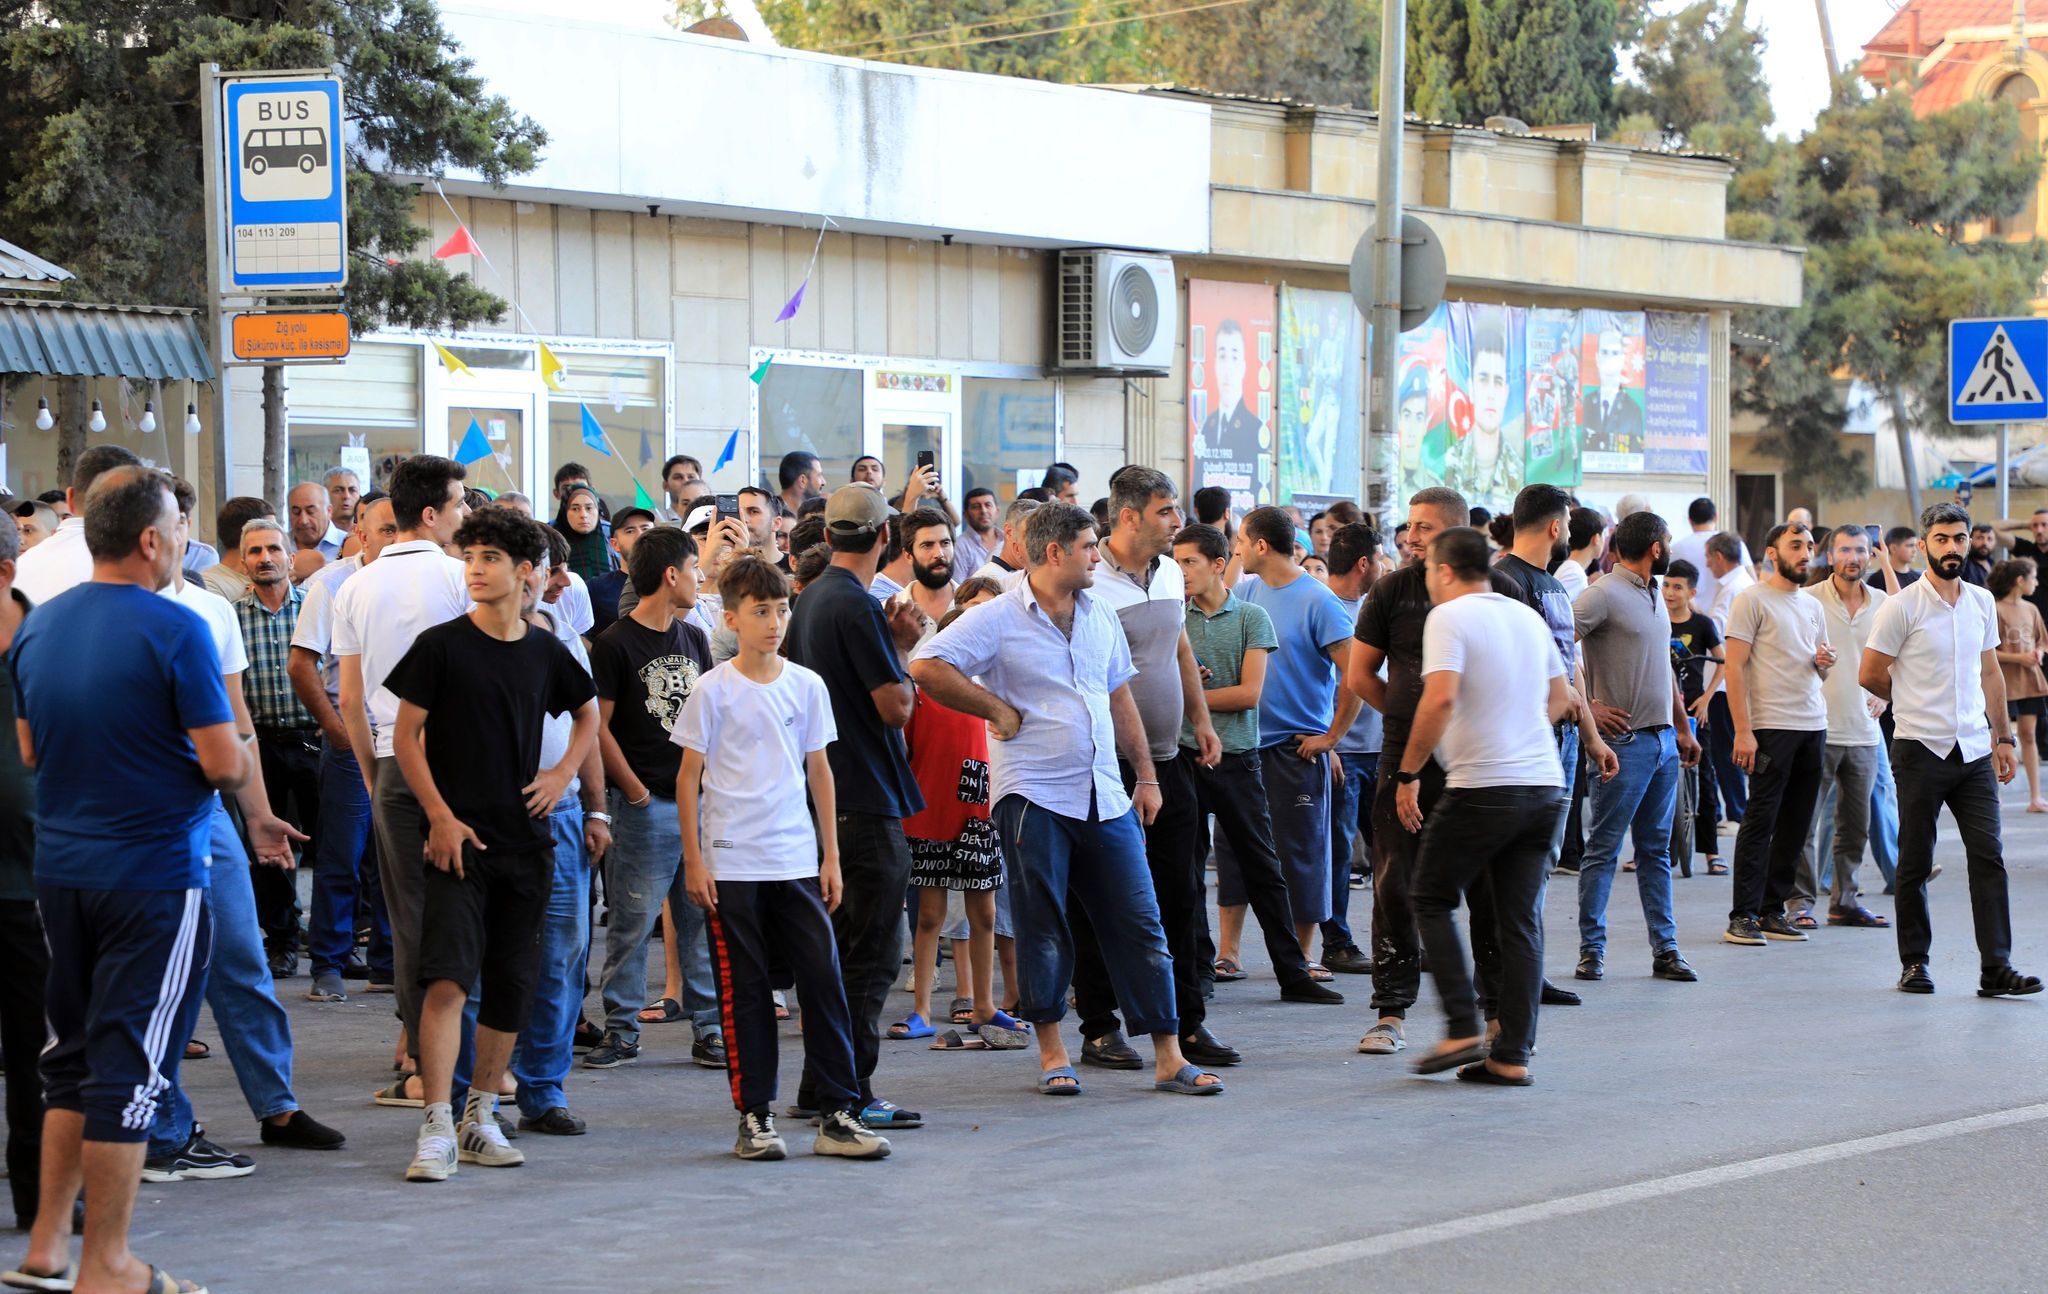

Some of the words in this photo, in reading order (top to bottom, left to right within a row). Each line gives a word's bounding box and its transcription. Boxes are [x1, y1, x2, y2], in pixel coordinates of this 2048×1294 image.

[258, 100, 310, 121] BUS
[237, 228, 253, 238] 104
[258, 227, 274, 237] 113
[279, 227, 296, 237] 209
[652, 656, 688, 668] BALMAIN
